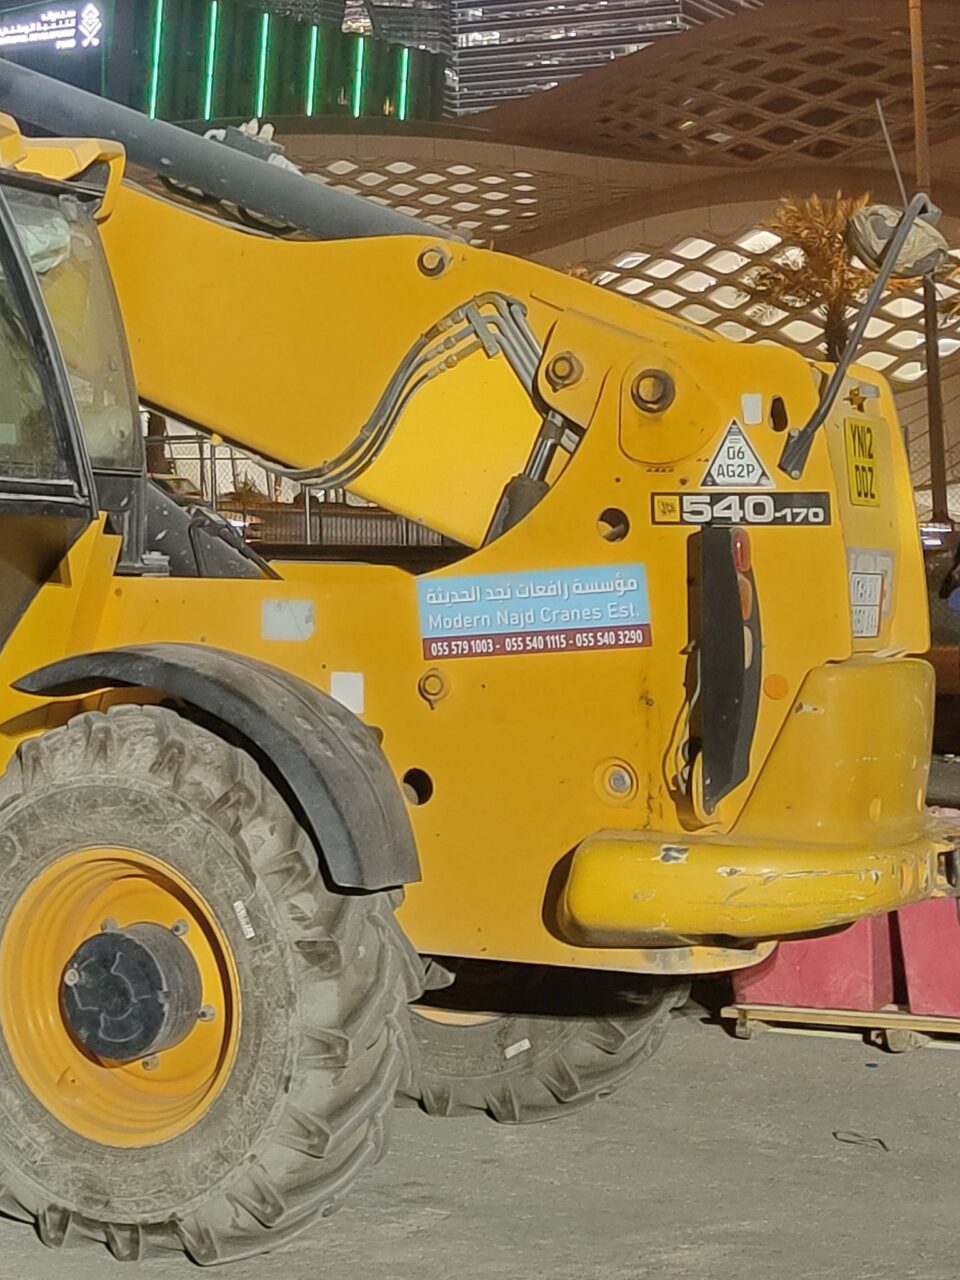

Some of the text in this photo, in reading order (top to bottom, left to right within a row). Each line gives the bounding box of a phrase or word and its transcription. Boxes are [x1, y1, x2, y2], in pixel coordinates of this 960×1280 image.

[717, 464, 755, 478] AG2P
[682, 495, 825, 523] 540-170
[426, 573, 638, 607] مؤسسة رافعات نجد الحديثة
[429, 613, 490, 631] Modern
[497, 608, 534, 628] Najd
[541, 604, 602, 623] Cranes
[431, 642, 449, 656] 055
[451, 640, 469, 655] 579
[471, 639, 493, 654] 1003
[505, 637, 523, 651] 055
[526, 636, 543, 650] 540
[545, 634, 567, 649] 1115
[575, 632, 594, 647] 055
[597, 631, 615, 646] 540
[618, 630, 643, 645] 3290
